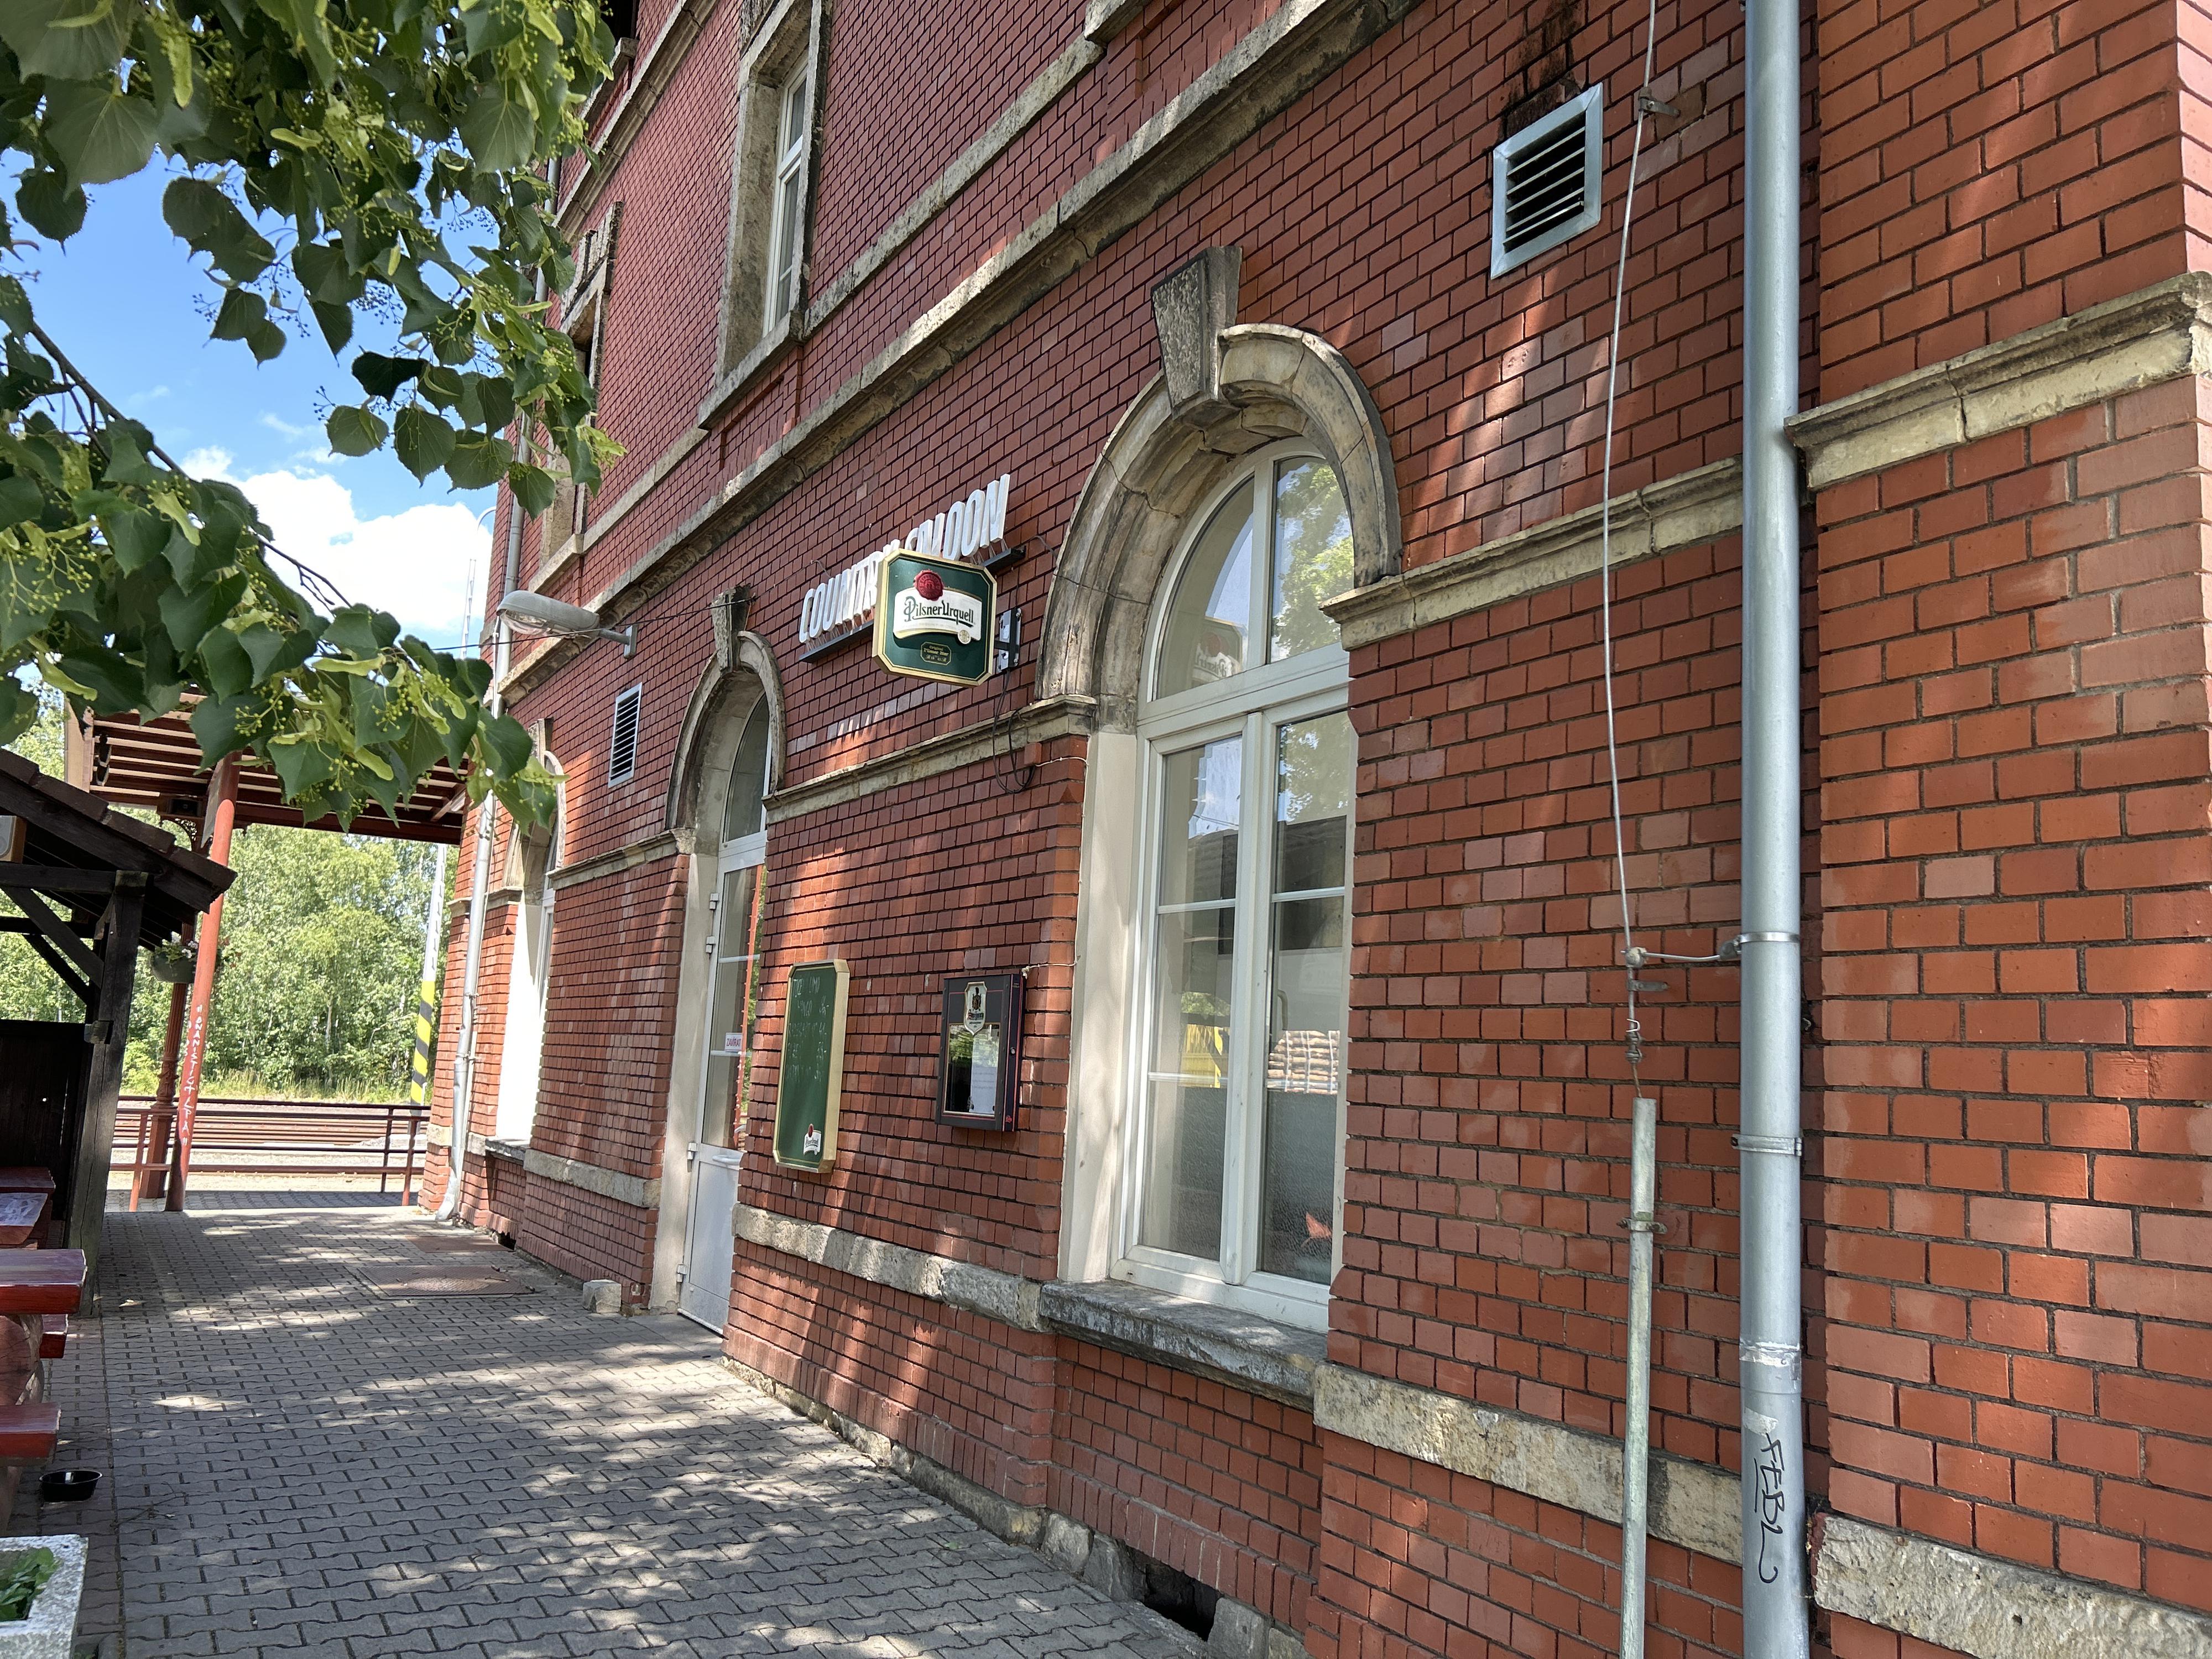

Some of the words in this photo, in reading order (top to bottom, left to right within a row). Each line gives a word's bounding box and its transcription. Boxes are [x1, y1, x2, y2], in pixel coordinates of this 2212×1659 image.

[799, 539, 900, 644] COUNTR
[903, 596, 942, 622] Pilsner
[941, 599, 974, 625] Urquell
